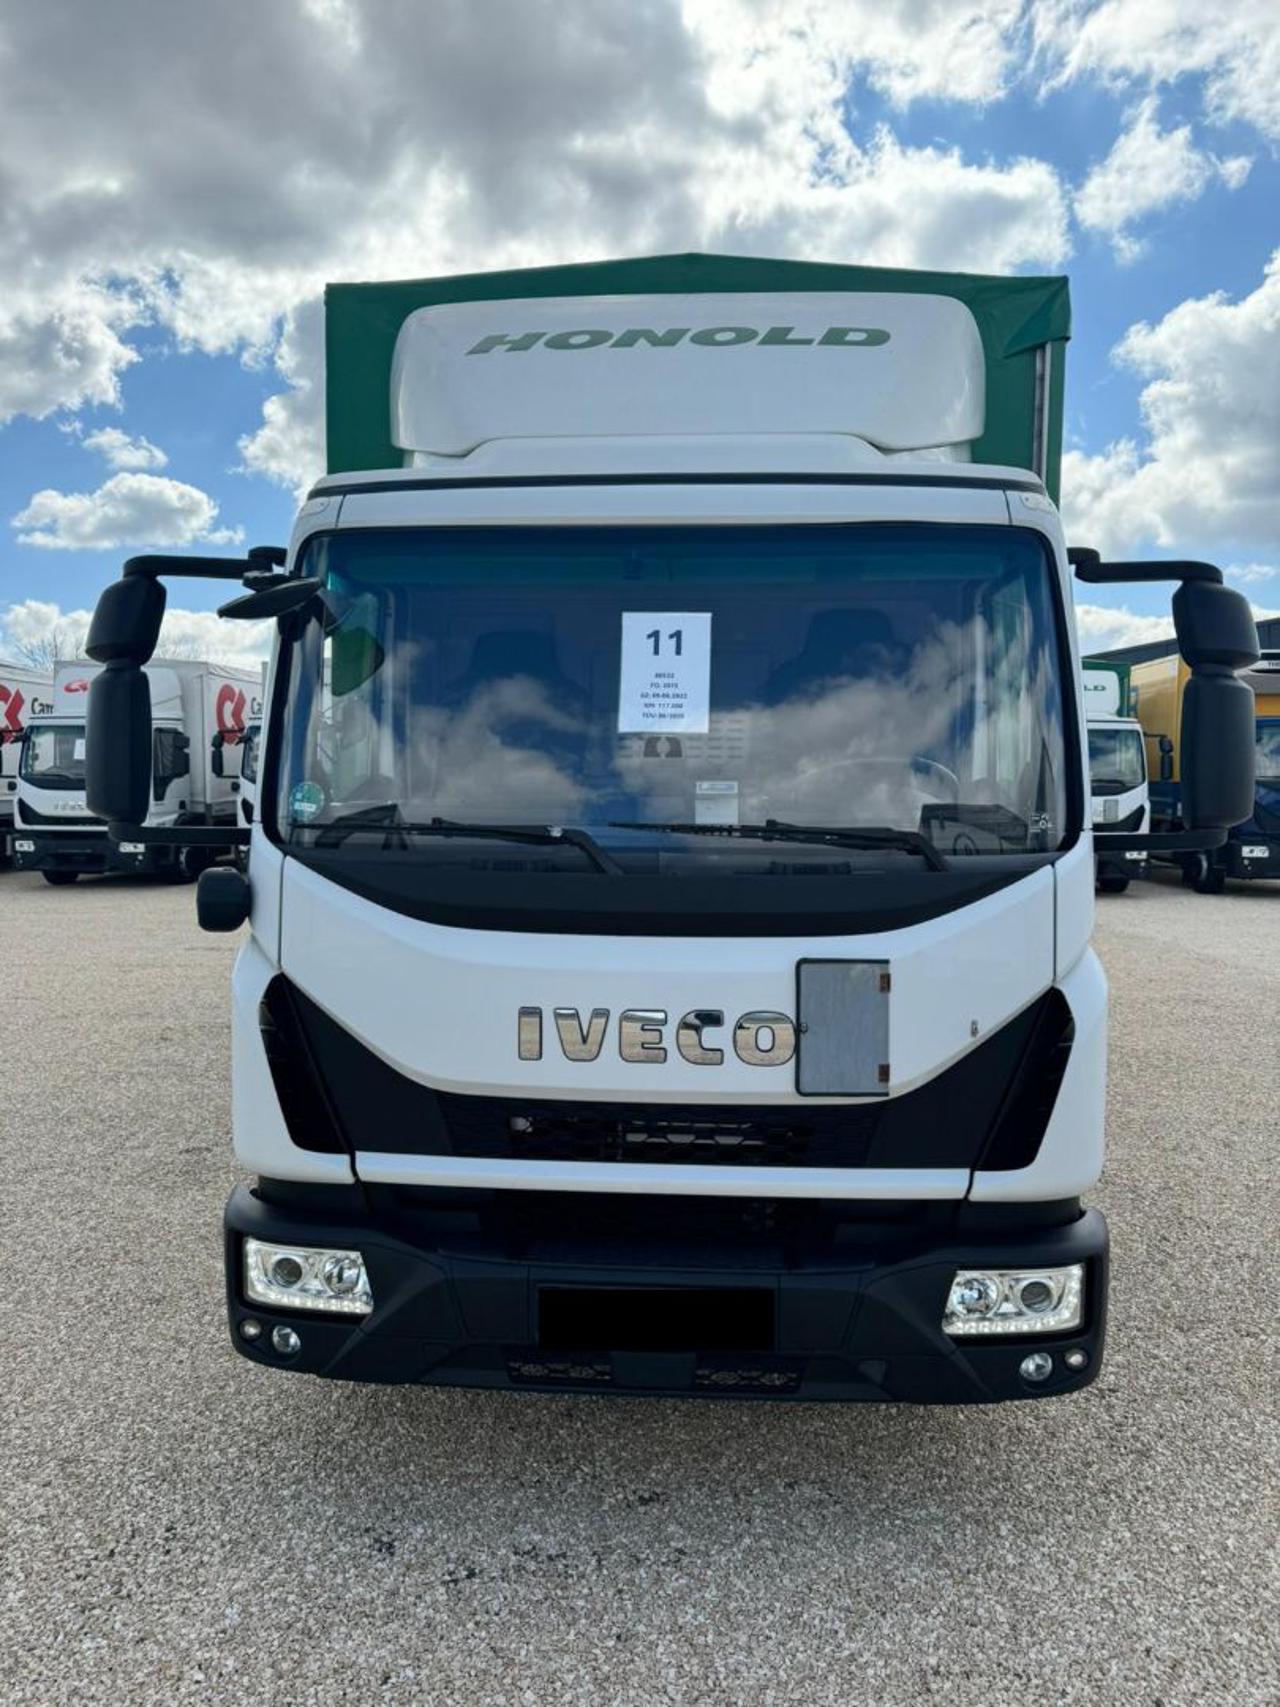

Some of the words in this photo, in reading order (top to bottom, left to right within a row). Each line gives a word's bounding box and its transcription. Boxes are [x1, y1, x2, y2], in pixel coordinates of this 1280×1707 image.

[465, 326, 891, 356] HONOLD
[646, 629, 683, 656] 11
[518, 1006, 796, 1066] IVECO
